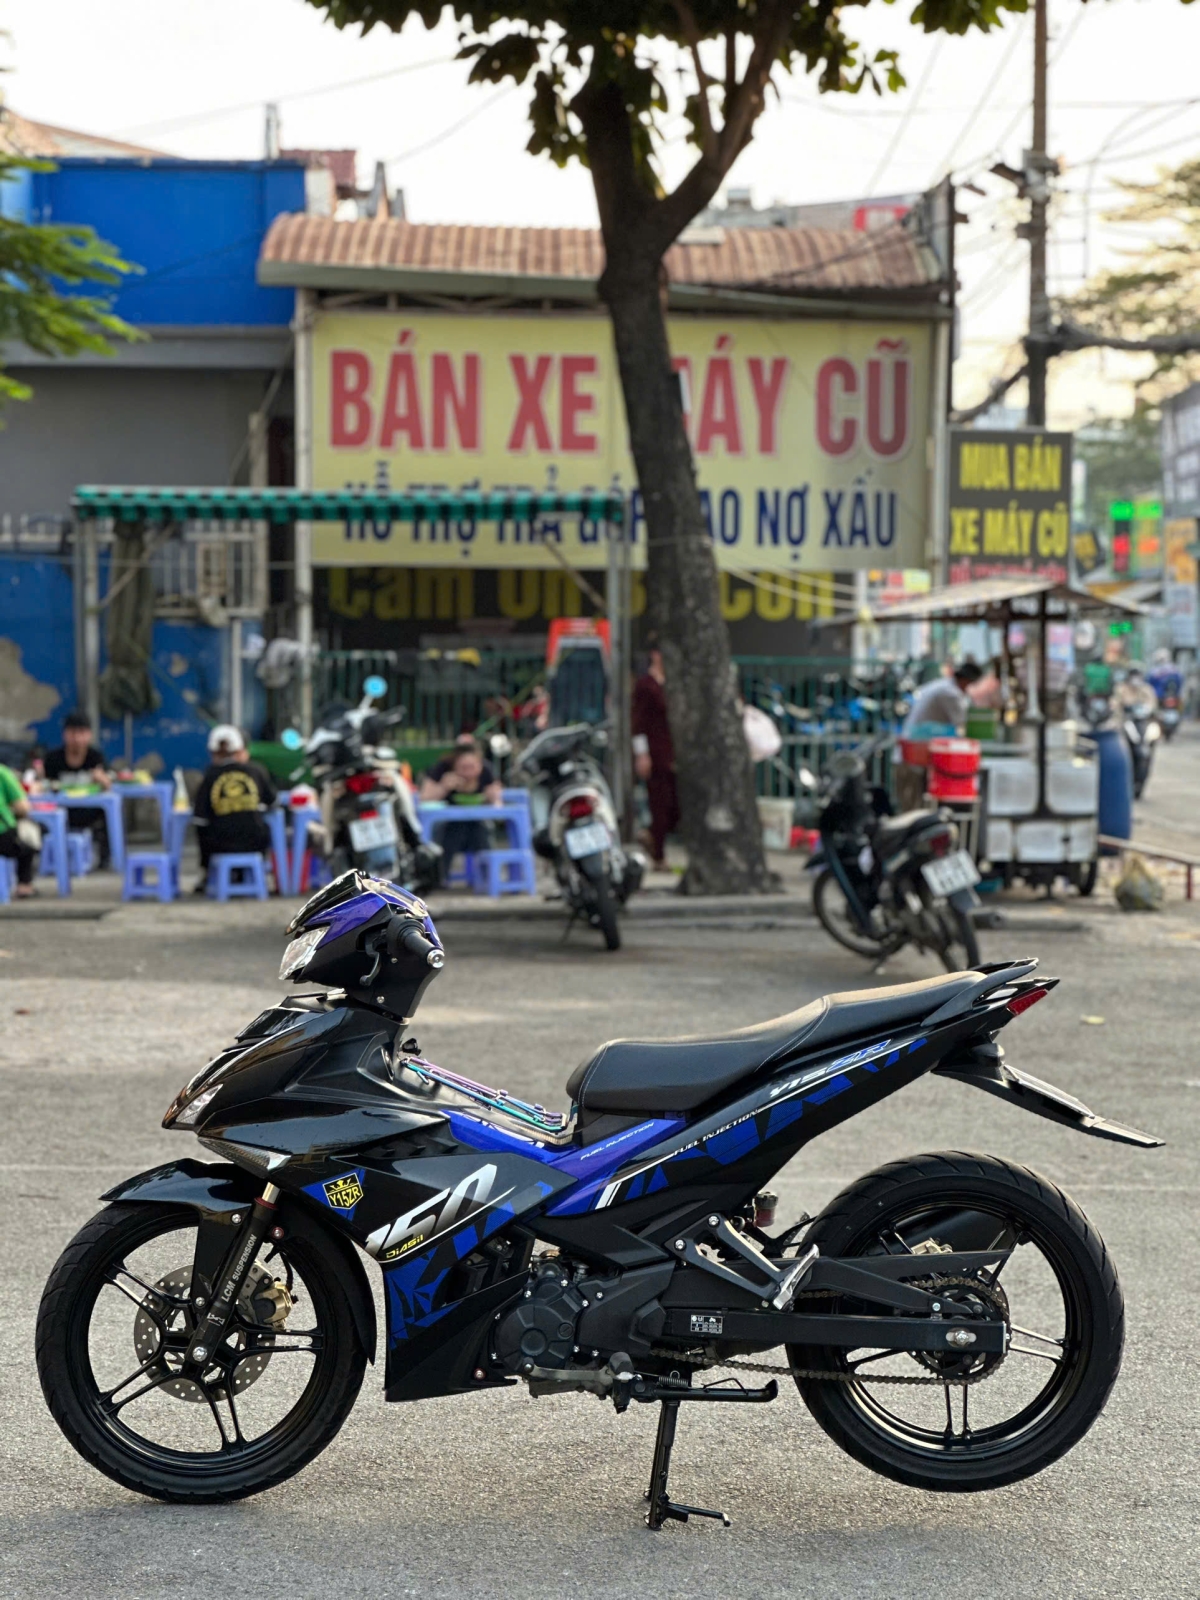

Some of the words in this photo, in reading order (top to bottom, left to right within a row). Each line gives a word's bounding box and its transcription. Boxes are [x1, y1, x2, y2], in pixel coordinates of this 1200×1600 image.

[329, 329, 480, 450] BÁN
[507, 354, 598, 452] XE
[672, 334, 788, 456] ÁY
[815, 338, 909, 457] CŨ
[959, 442, 1011, 490] MUA
[1014, 435, 1063, 491] BÁN
[757, 484, 812, 561] NỢ
[822, 469, 897, 547] XẤU
[950, 508, 980, 556] XE
[983, 500, 1035, 556] MÁY
[1037, 501, 1069, 557] CŨ
[580, 1146, 605, 1160] FUEL
[605, 1122, 655, 1148] INJECTION
[673, 1140, 701, 1156] FUEL
[702, 1108, 760, 1142] INJECTION
[329, 1186, 361, 1207] Y15ZR
[221, 1280, 236, 1303] LCM
[232, 1233, 257, 1281] SUSPENSION
